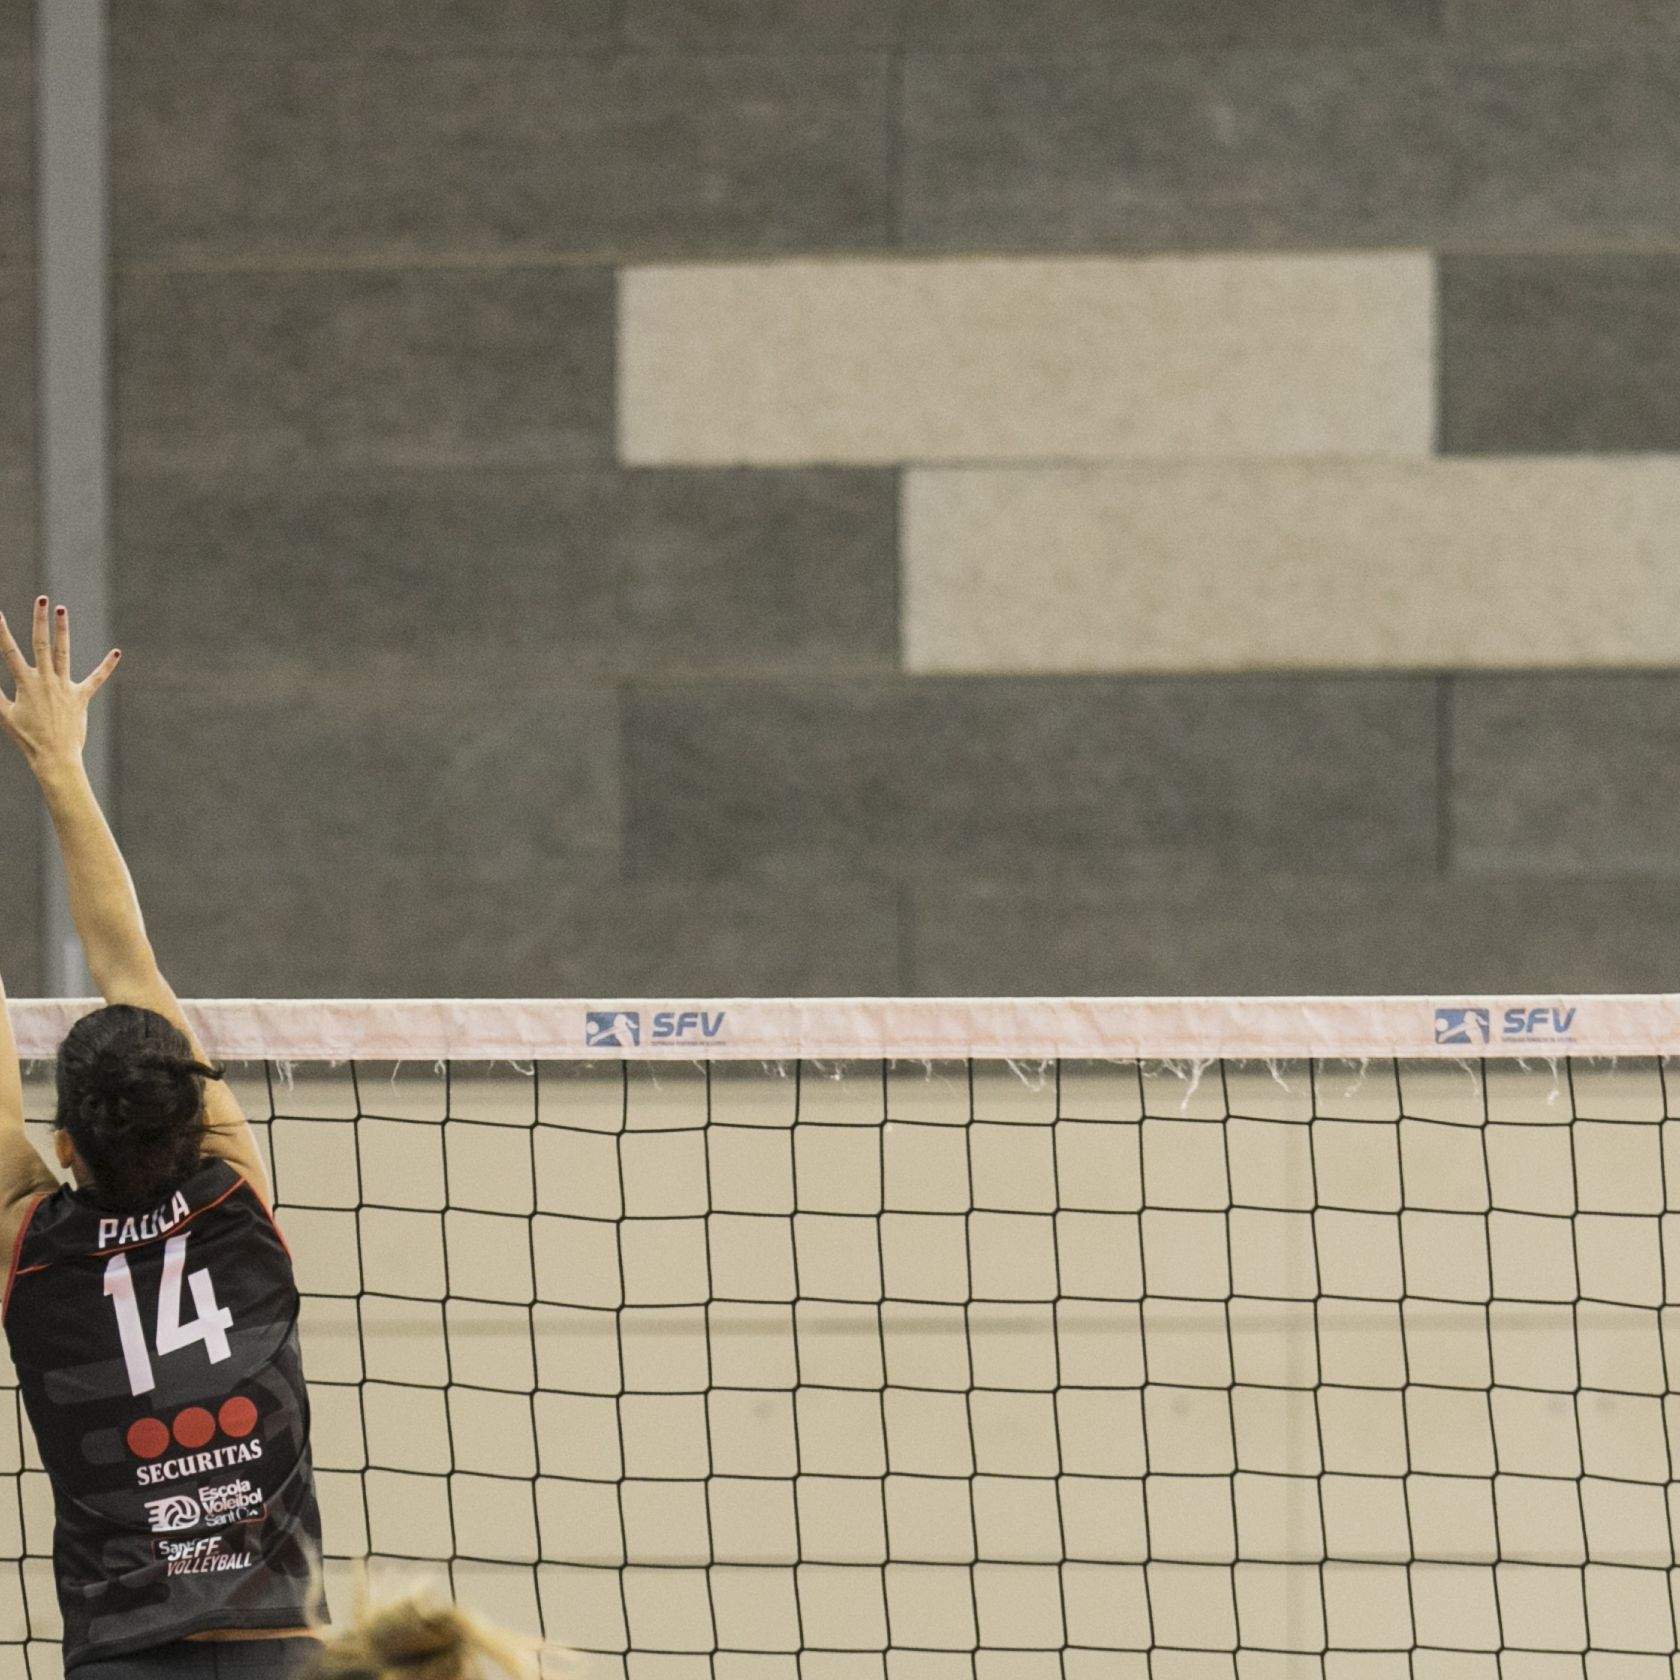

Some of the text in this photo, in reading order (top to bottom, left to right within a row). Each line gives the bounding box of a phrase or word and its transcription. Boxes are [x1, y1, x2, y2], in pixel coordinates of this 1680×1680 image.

[652, 1011, 726, 1037] SFV
[1503, 1008, 1576, 1033] SFV
[98, 1190, 190, 1248] PAULA
[103, 1231, 233, 1396] 14
[136, 1439, 263, 1486] SECURITAS
[198, 1479, 251, 1502] Escola
[202, 1488, 263, 1516] Voleibol
[167, 1551, 252, 1577] VOLLEYBALL
